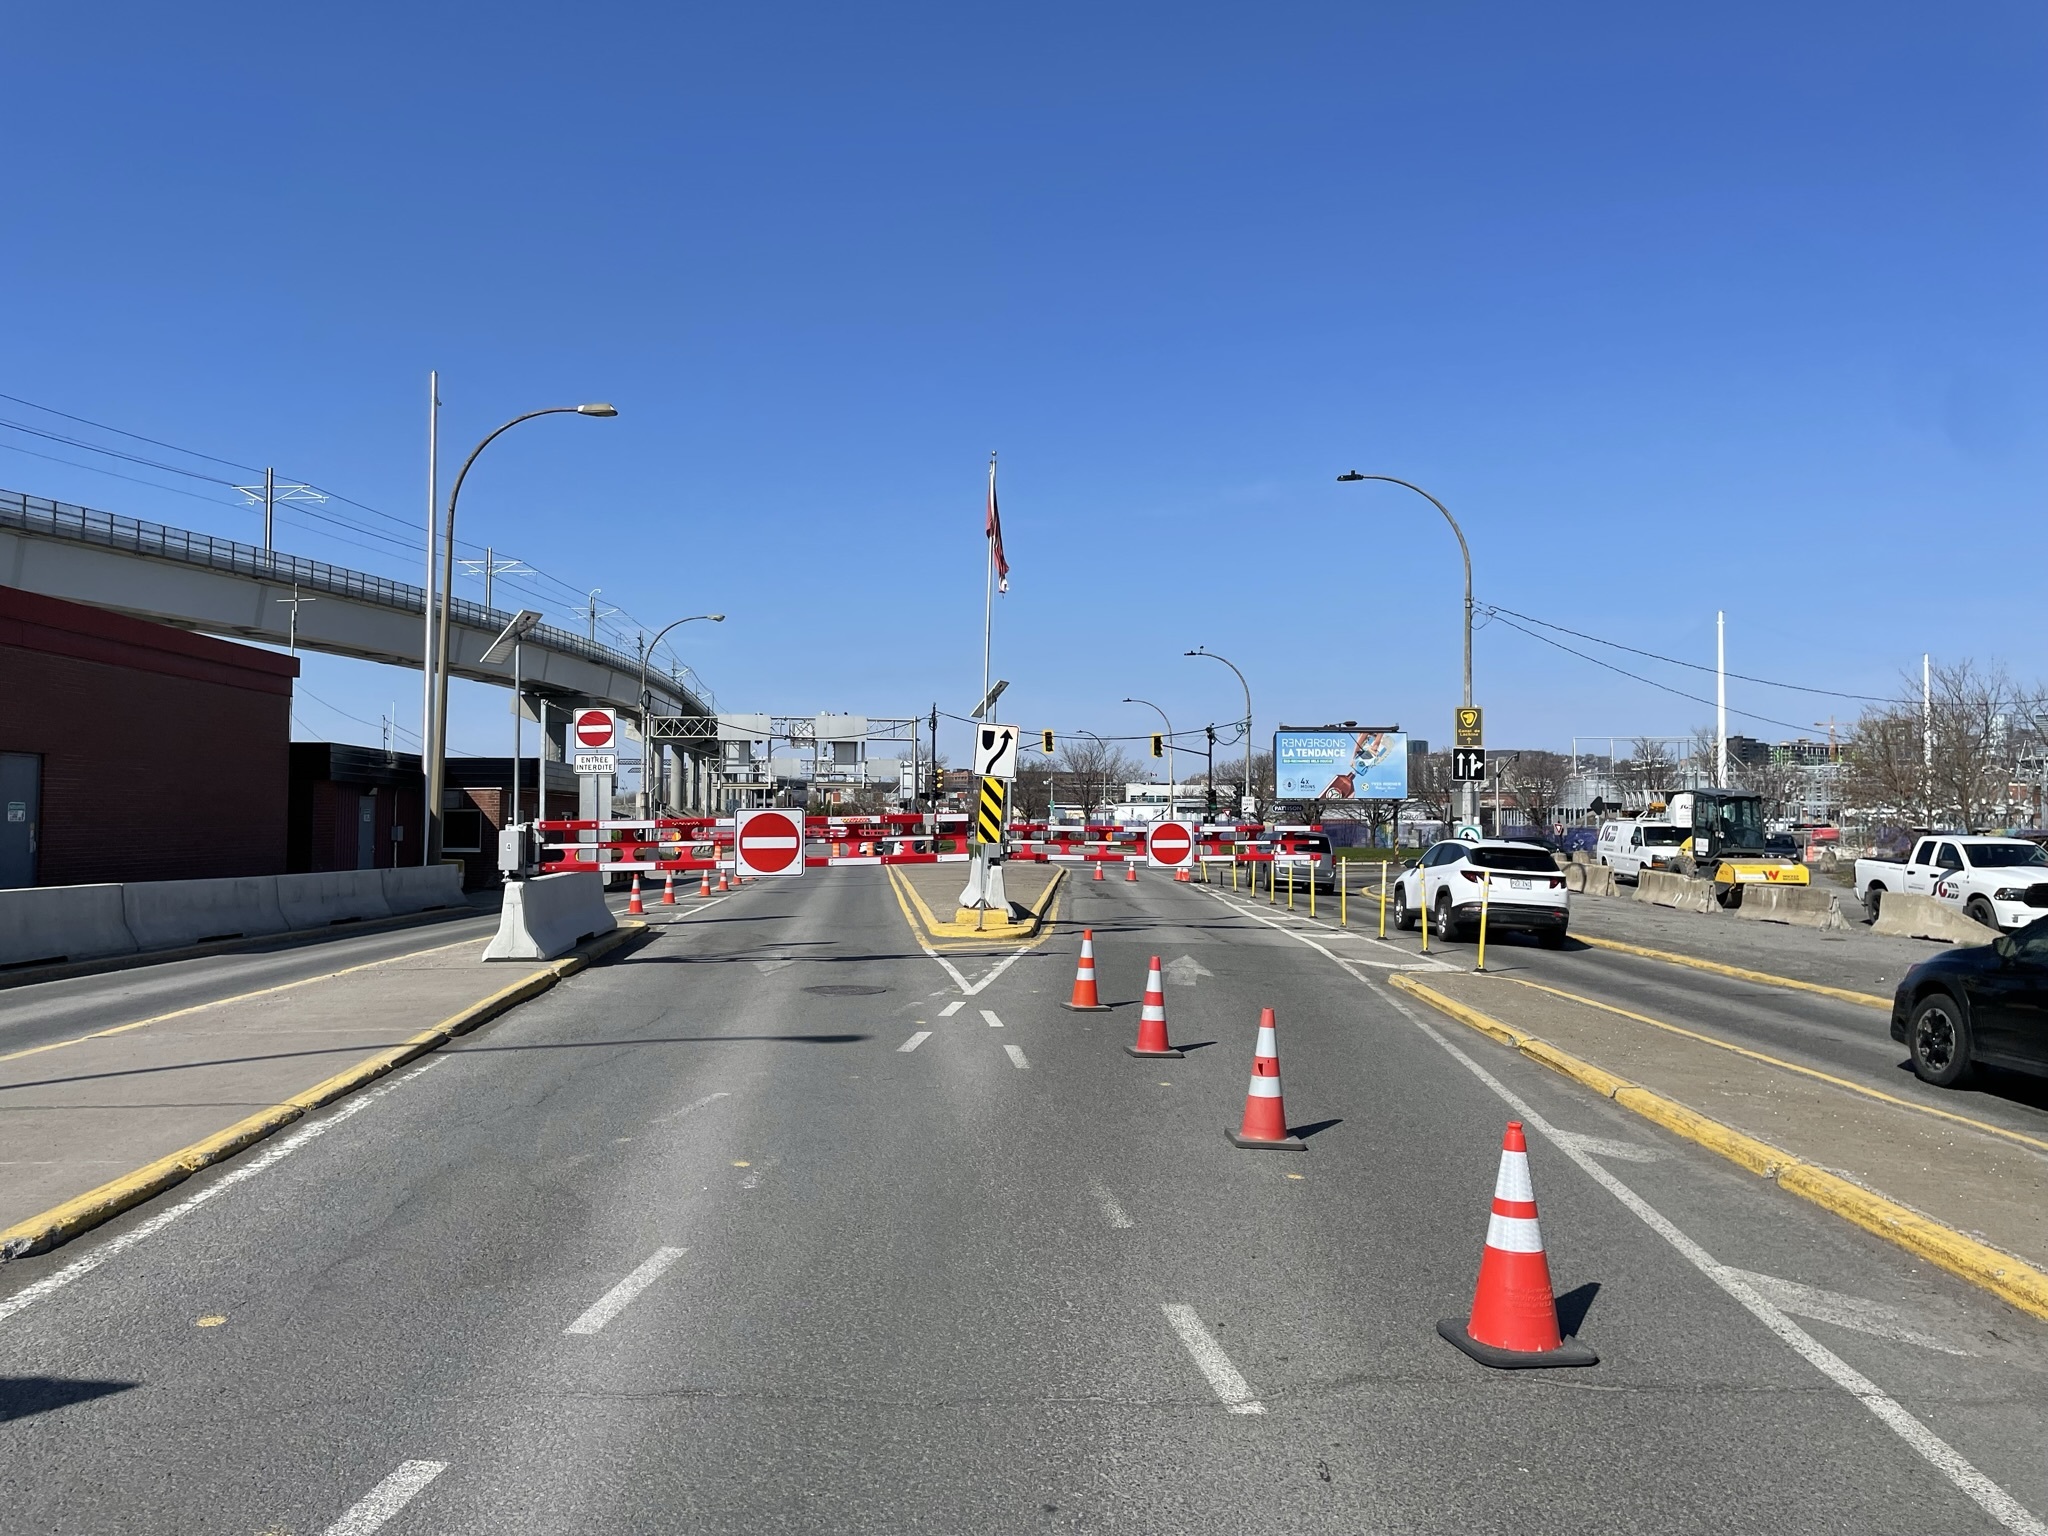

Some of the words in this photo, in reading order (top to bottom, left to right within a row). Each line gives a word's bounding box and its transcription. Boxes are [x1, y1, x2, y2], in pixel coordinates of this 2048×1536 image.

[1282, 738, 1346, 747] RENVERSONS
[1282, 748, 1294, 757] LA
[1296, 748, 1346, 757] TENDANCE
